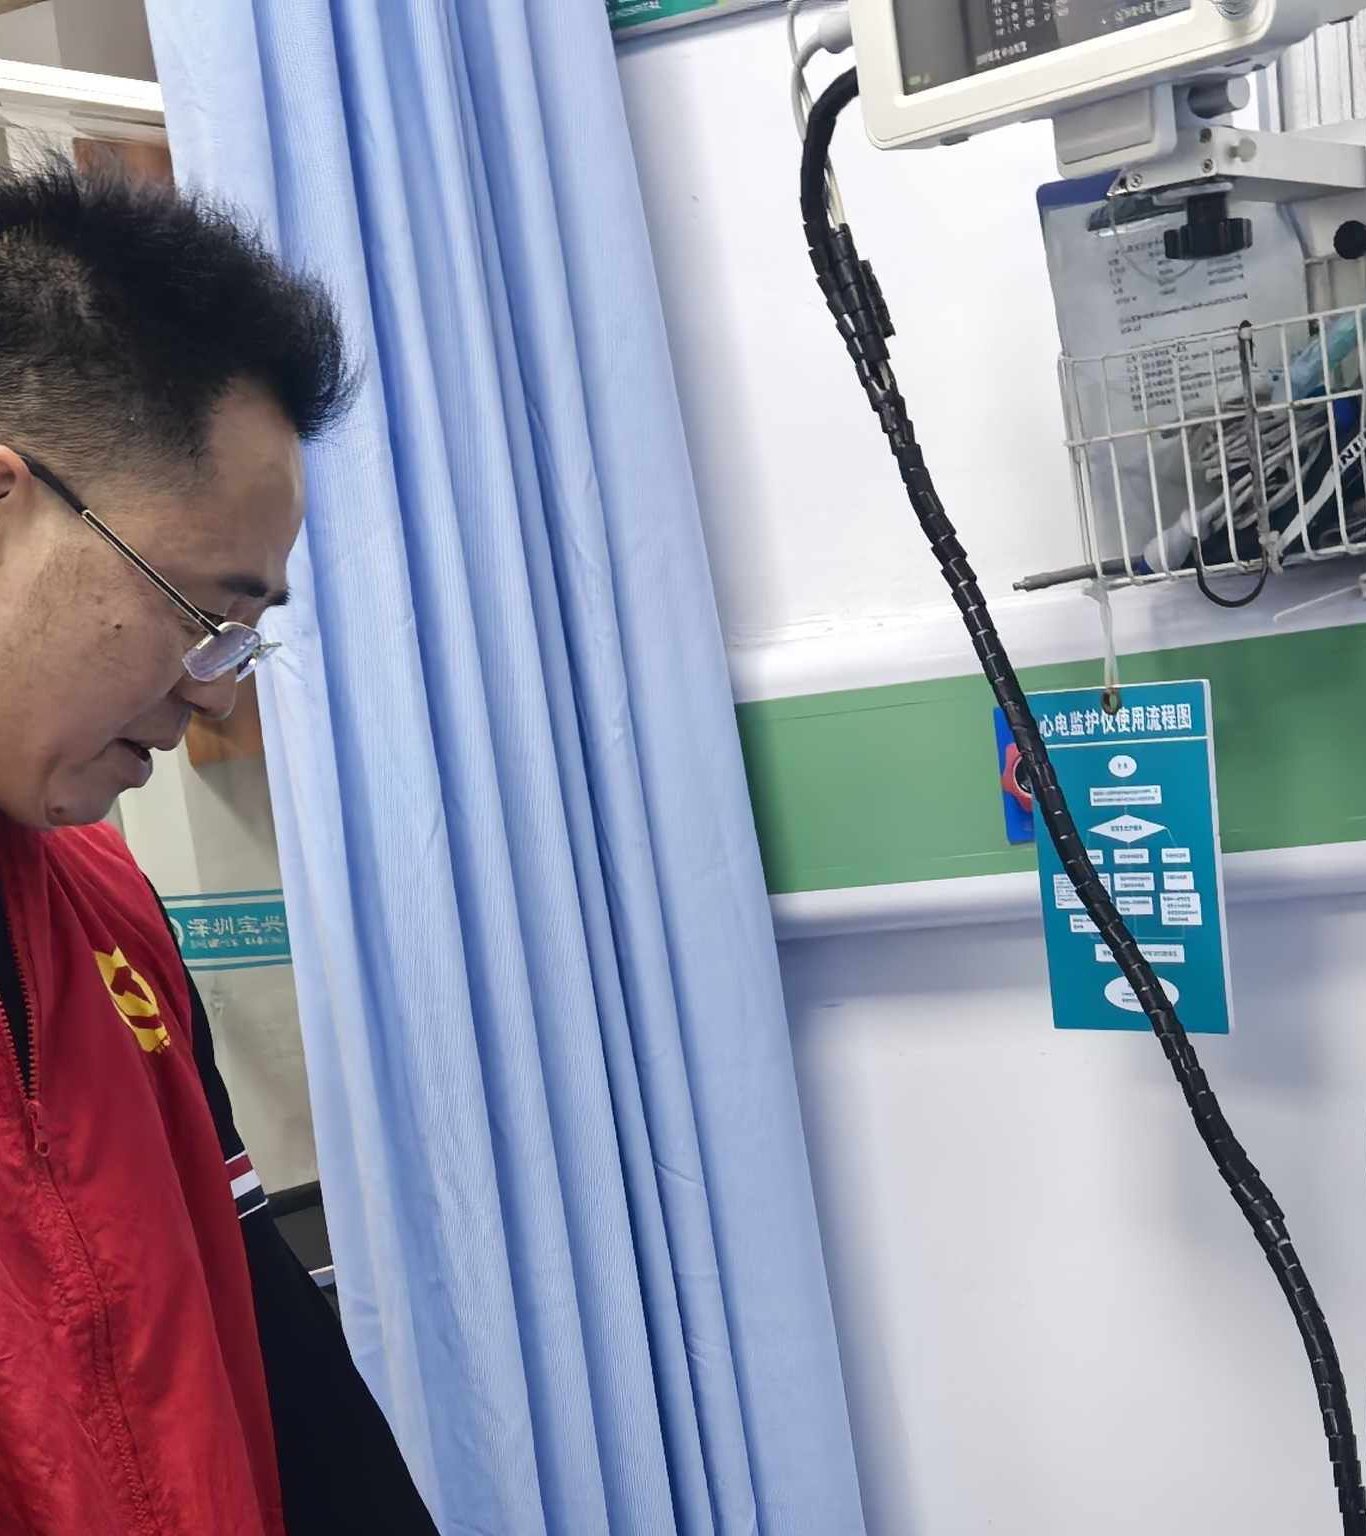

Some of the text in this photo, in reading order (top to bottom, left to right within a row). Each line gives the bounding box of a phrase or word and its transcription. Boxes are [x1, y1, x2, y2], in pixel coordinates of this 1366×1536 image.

[1039, 703, 1193, 739] 心电监护仪使用流程图
